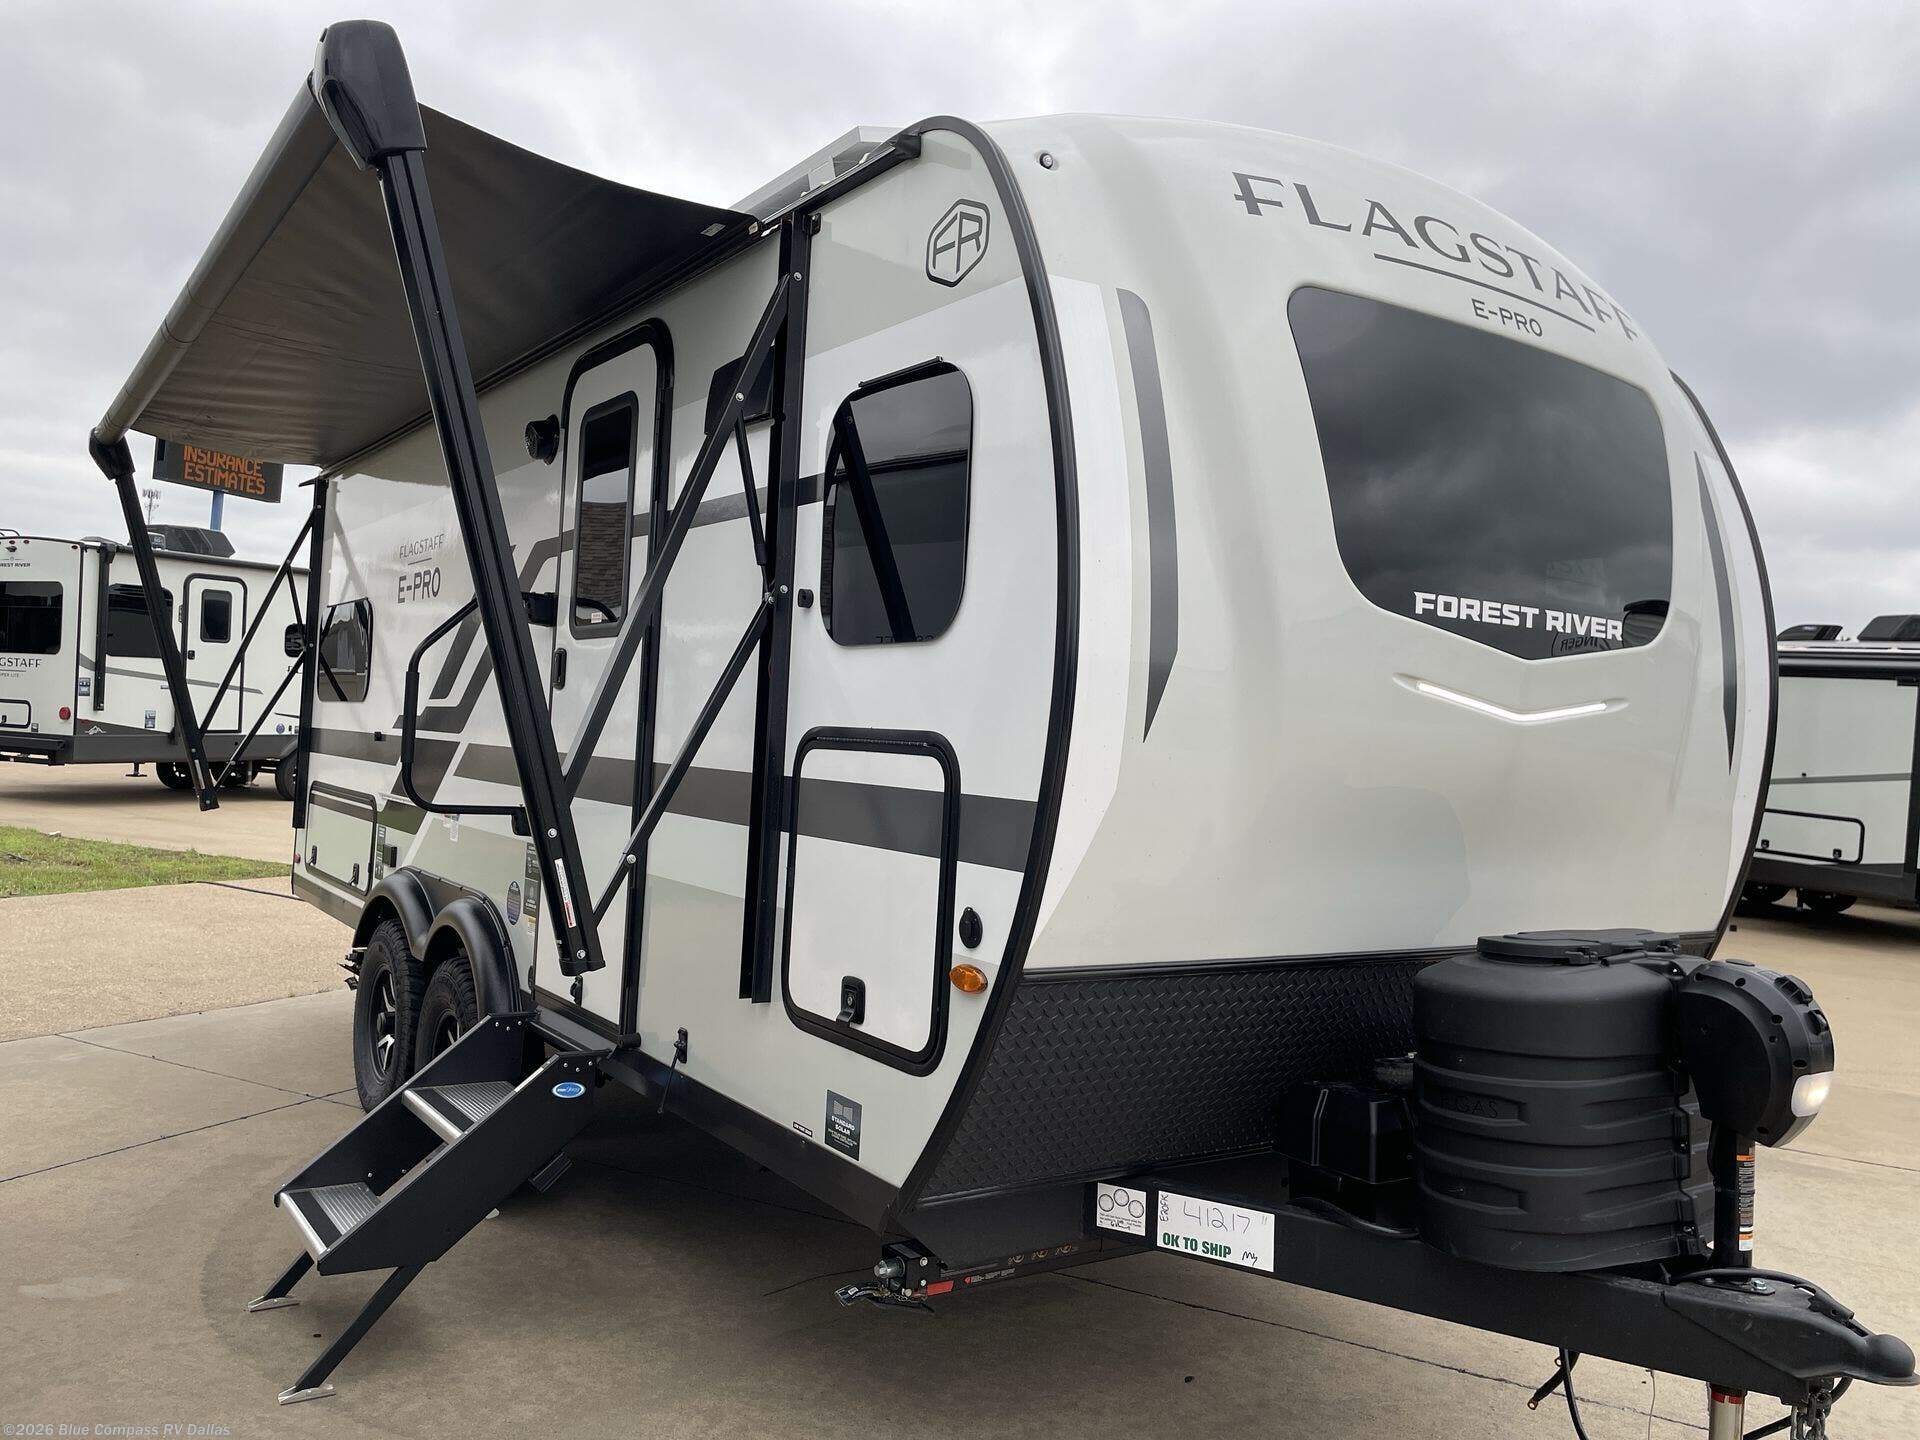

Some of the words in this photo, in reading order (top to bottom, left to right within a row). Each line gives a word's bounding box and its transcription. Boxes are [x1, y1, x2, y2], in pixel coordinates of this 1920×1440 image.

[1232, 171, 1638, 341] FLAGSTAFF
[1471, 297, 1543, 337] E-PRO
[183, 444, 263, 477] INSURANCE
[184, 461, 266, 495] ESTIMATES
[400, 533, 445, 559] FLAGSTAFF
[398, 567, 441, 604] E-PRO
[1413, 591, 1539, 629] FOREST
[1545, 609, 1623, 641] RIVER
[1162, 1232, 1180, 1248] OK
[1183, 1236, 1198, 1251] TO
[1202, 1240, 1232, 1258] SHIP
